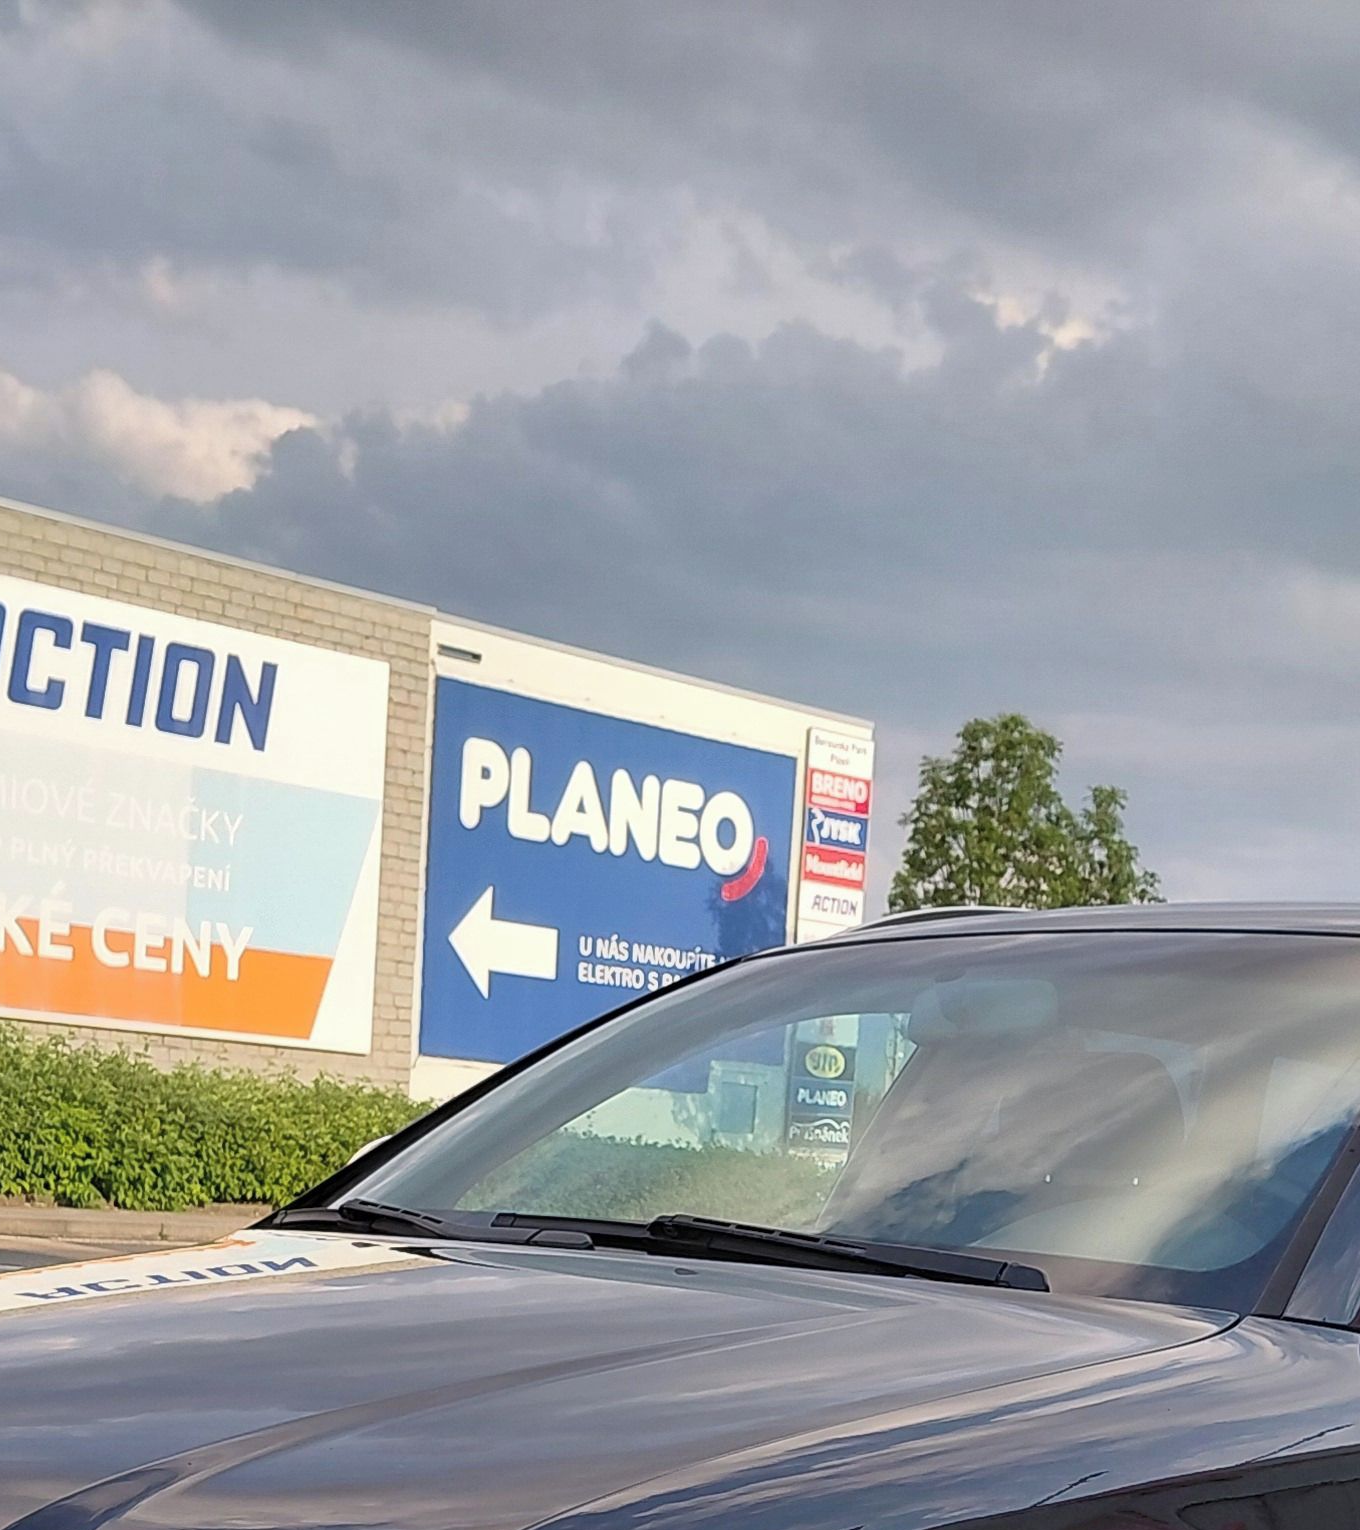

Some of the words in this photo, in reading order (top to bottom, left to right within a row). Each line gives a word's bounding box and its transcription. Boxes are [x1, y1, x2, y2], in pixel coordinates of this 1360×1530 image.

[811, 771, 869, 804] BRENO
[106, 791, 244, 848] ZNAČKY
[458, 737, 755, 876] PLANEO
[820, 816, 862, 845] JYSK
[10, 837, 77, 868] PLNÝ
[811, 894, 859, 916] ACTION
[90, 906, 254, 982] CENY
[579, 935, 594, 957] U
[596, 933, 630, 962] NÁS
[632, 943, 717, 971] NAKOUPÍTE
[578, 961, 645, 991] ELEKTRO
[647, 971, 659, 992] S
[797, 1087, 847, 1107] PLANEO
